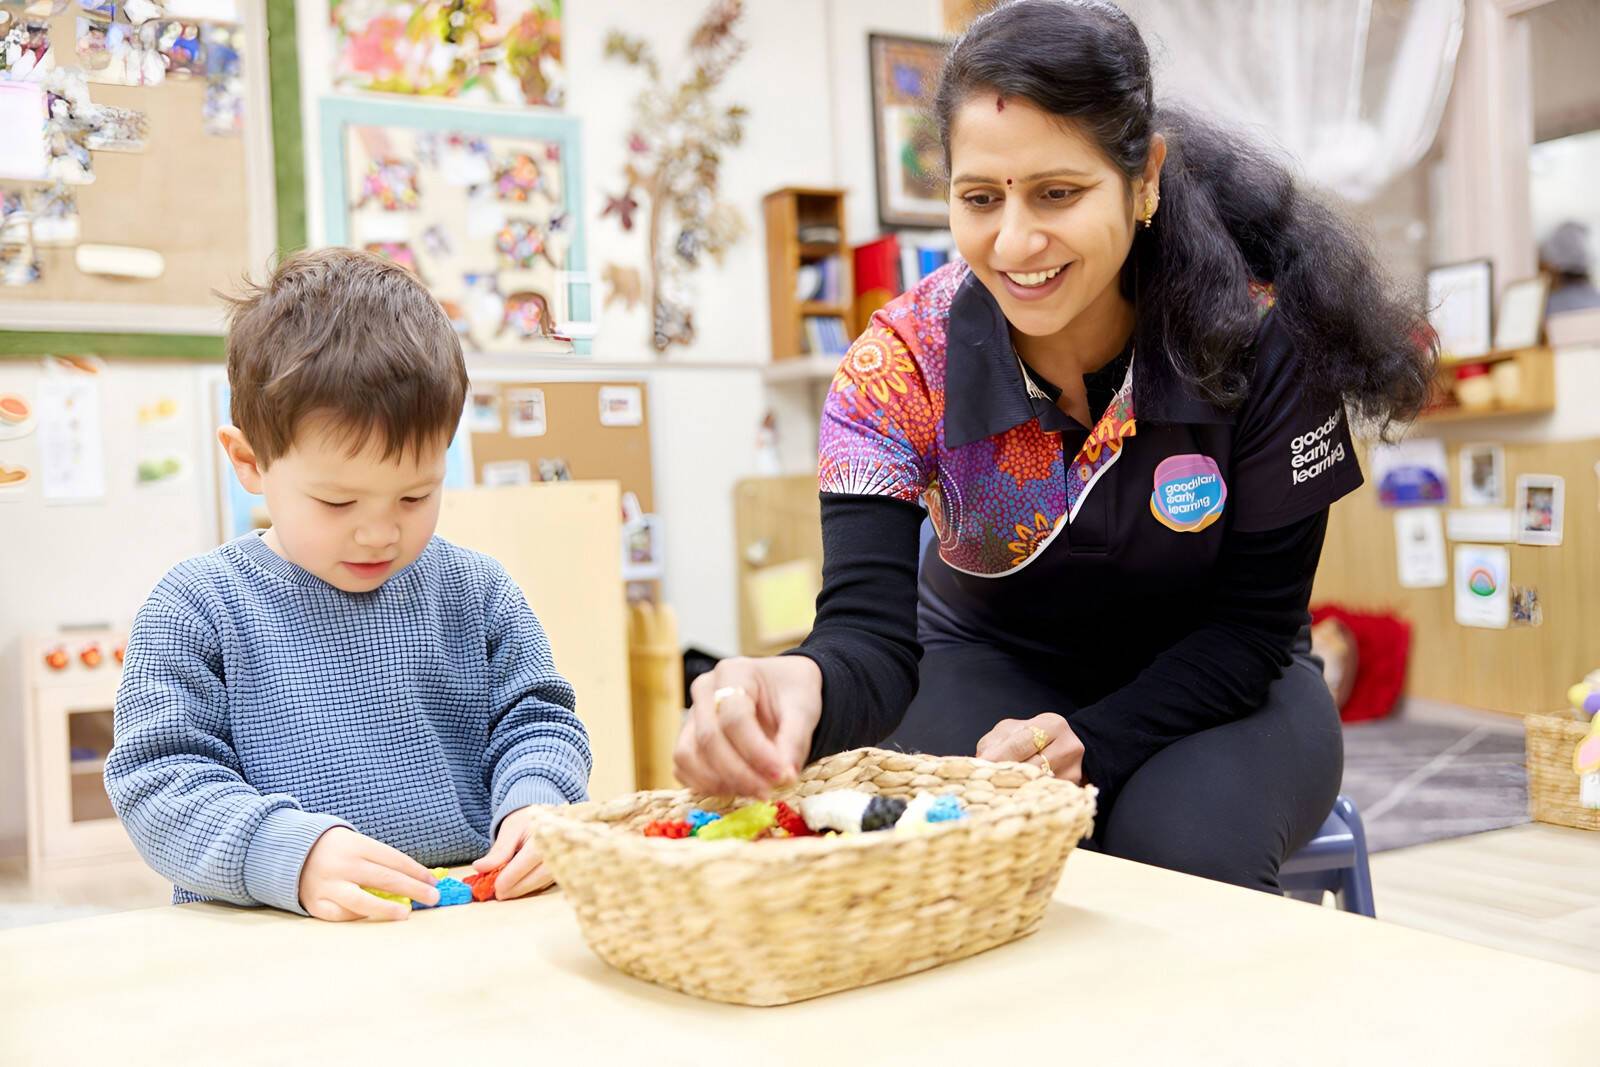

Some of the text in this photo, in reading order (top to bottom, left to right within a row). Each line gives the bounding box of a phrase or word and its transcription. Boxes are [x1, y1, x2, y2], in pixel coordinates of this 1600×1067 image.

[1291, 438, 1331, 468] early
[1292, 442, 1345, 486] learnig
[1166, 491, 1195, 505] early
